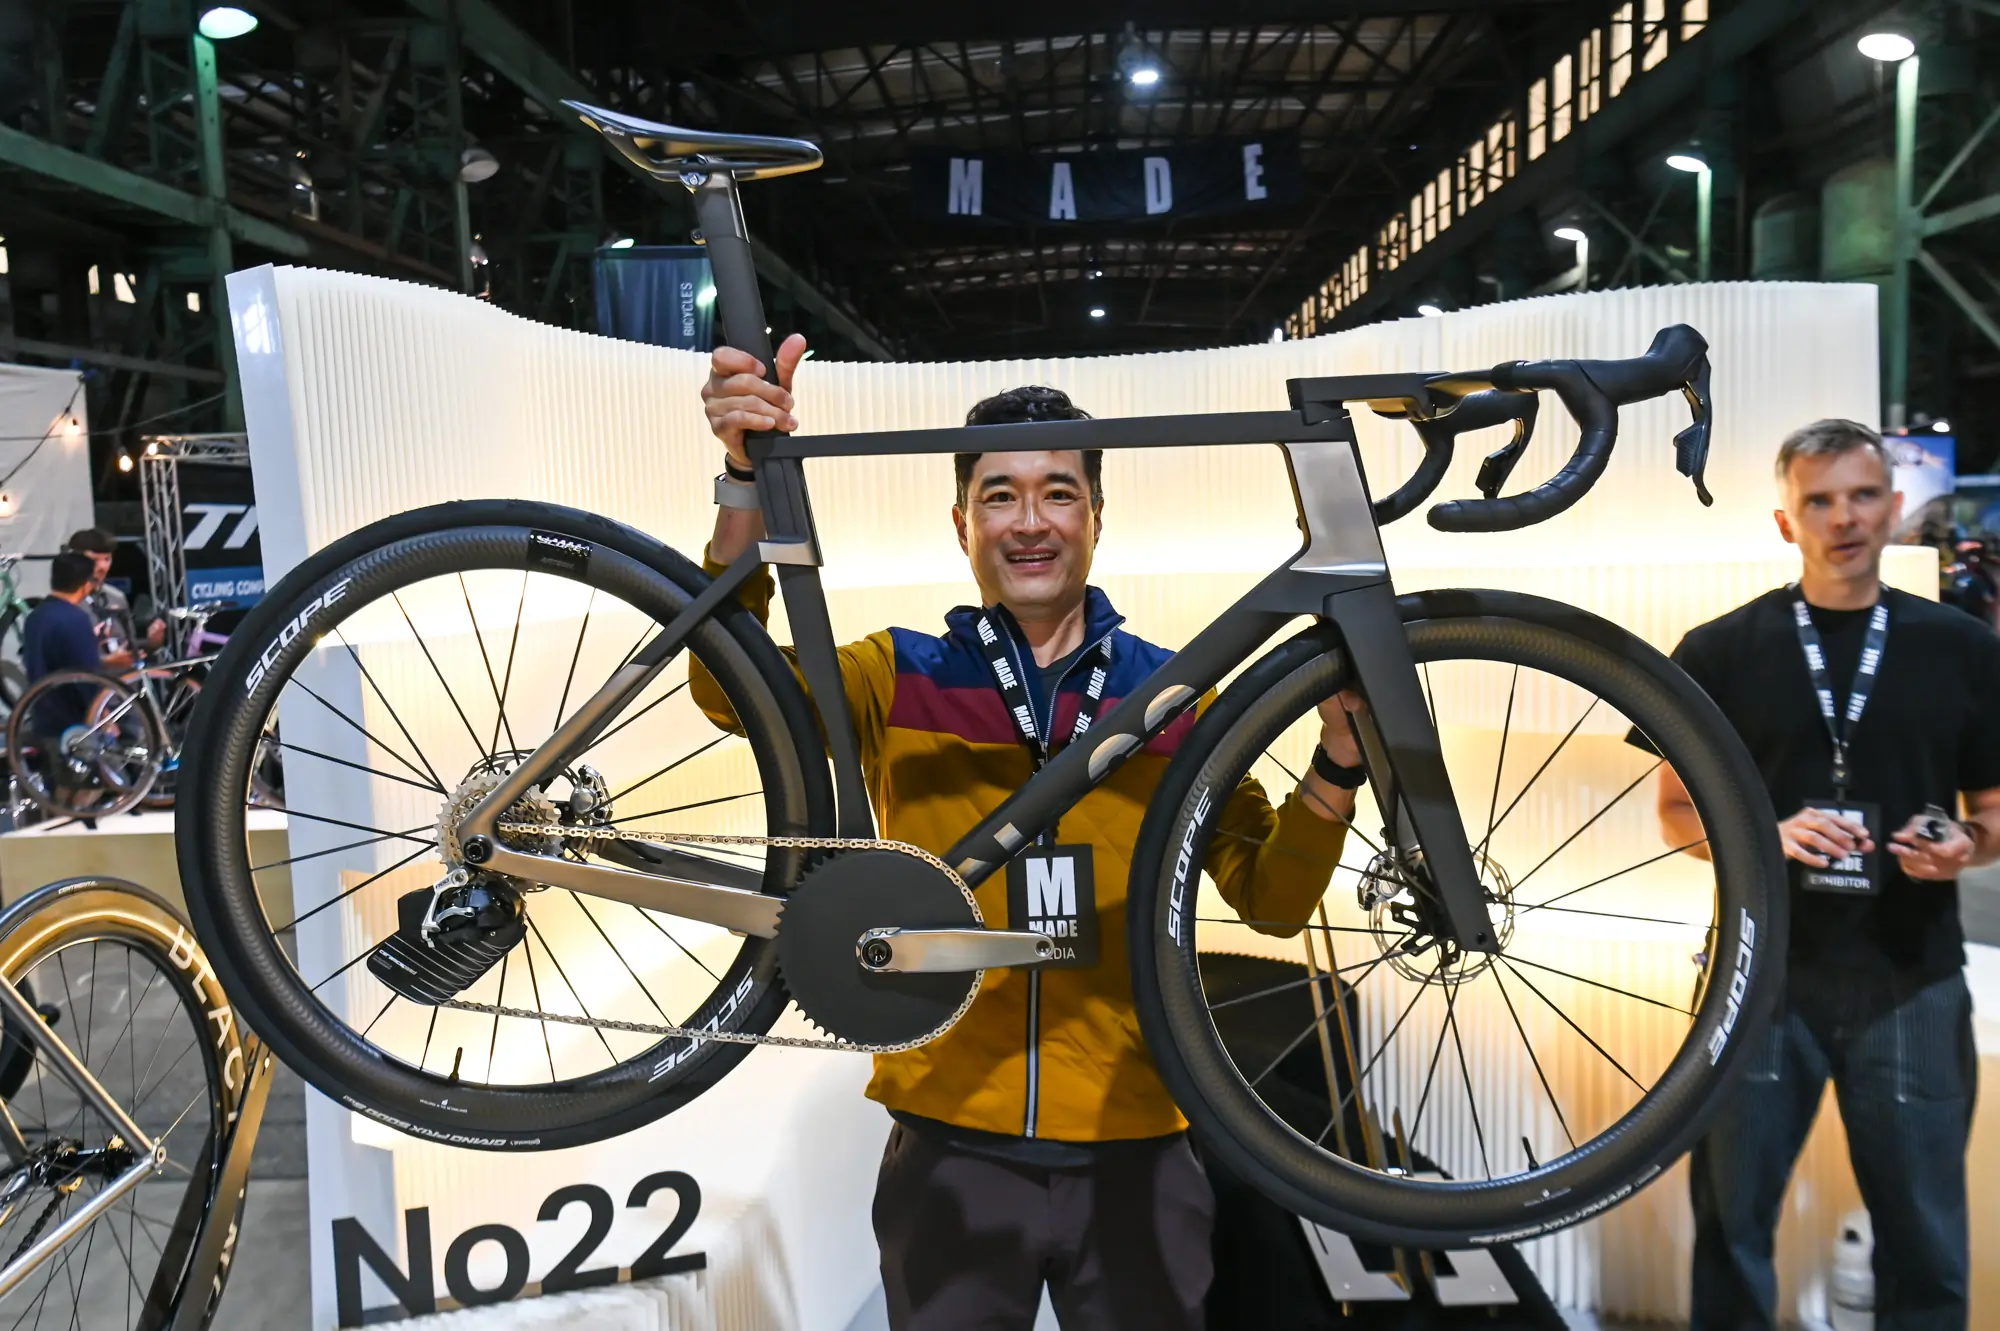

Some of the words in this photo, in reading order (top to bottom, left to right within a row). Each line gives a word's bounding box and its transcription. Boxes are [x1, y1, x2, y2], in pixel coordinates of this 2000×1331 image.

[681, 282, 696, 337] BICYCLES
[191, 581, 234, 599] CYCLING
[245, 578, 351, 700] SCOPE
[991, 657, 1018, 690] MADE
[1086, 666, 1107, 700] MADE
[1013, 704, 1037, 740] MADE
[1025, 856, 1077, 917] M
[1168, 786, 1212, 947] SCOPE
[1808, 873, 1871, 890] EXHIBITOR
[1707, 907, 1756, 1067] SCOPE
[332, 1170, 707, 1329] No22
